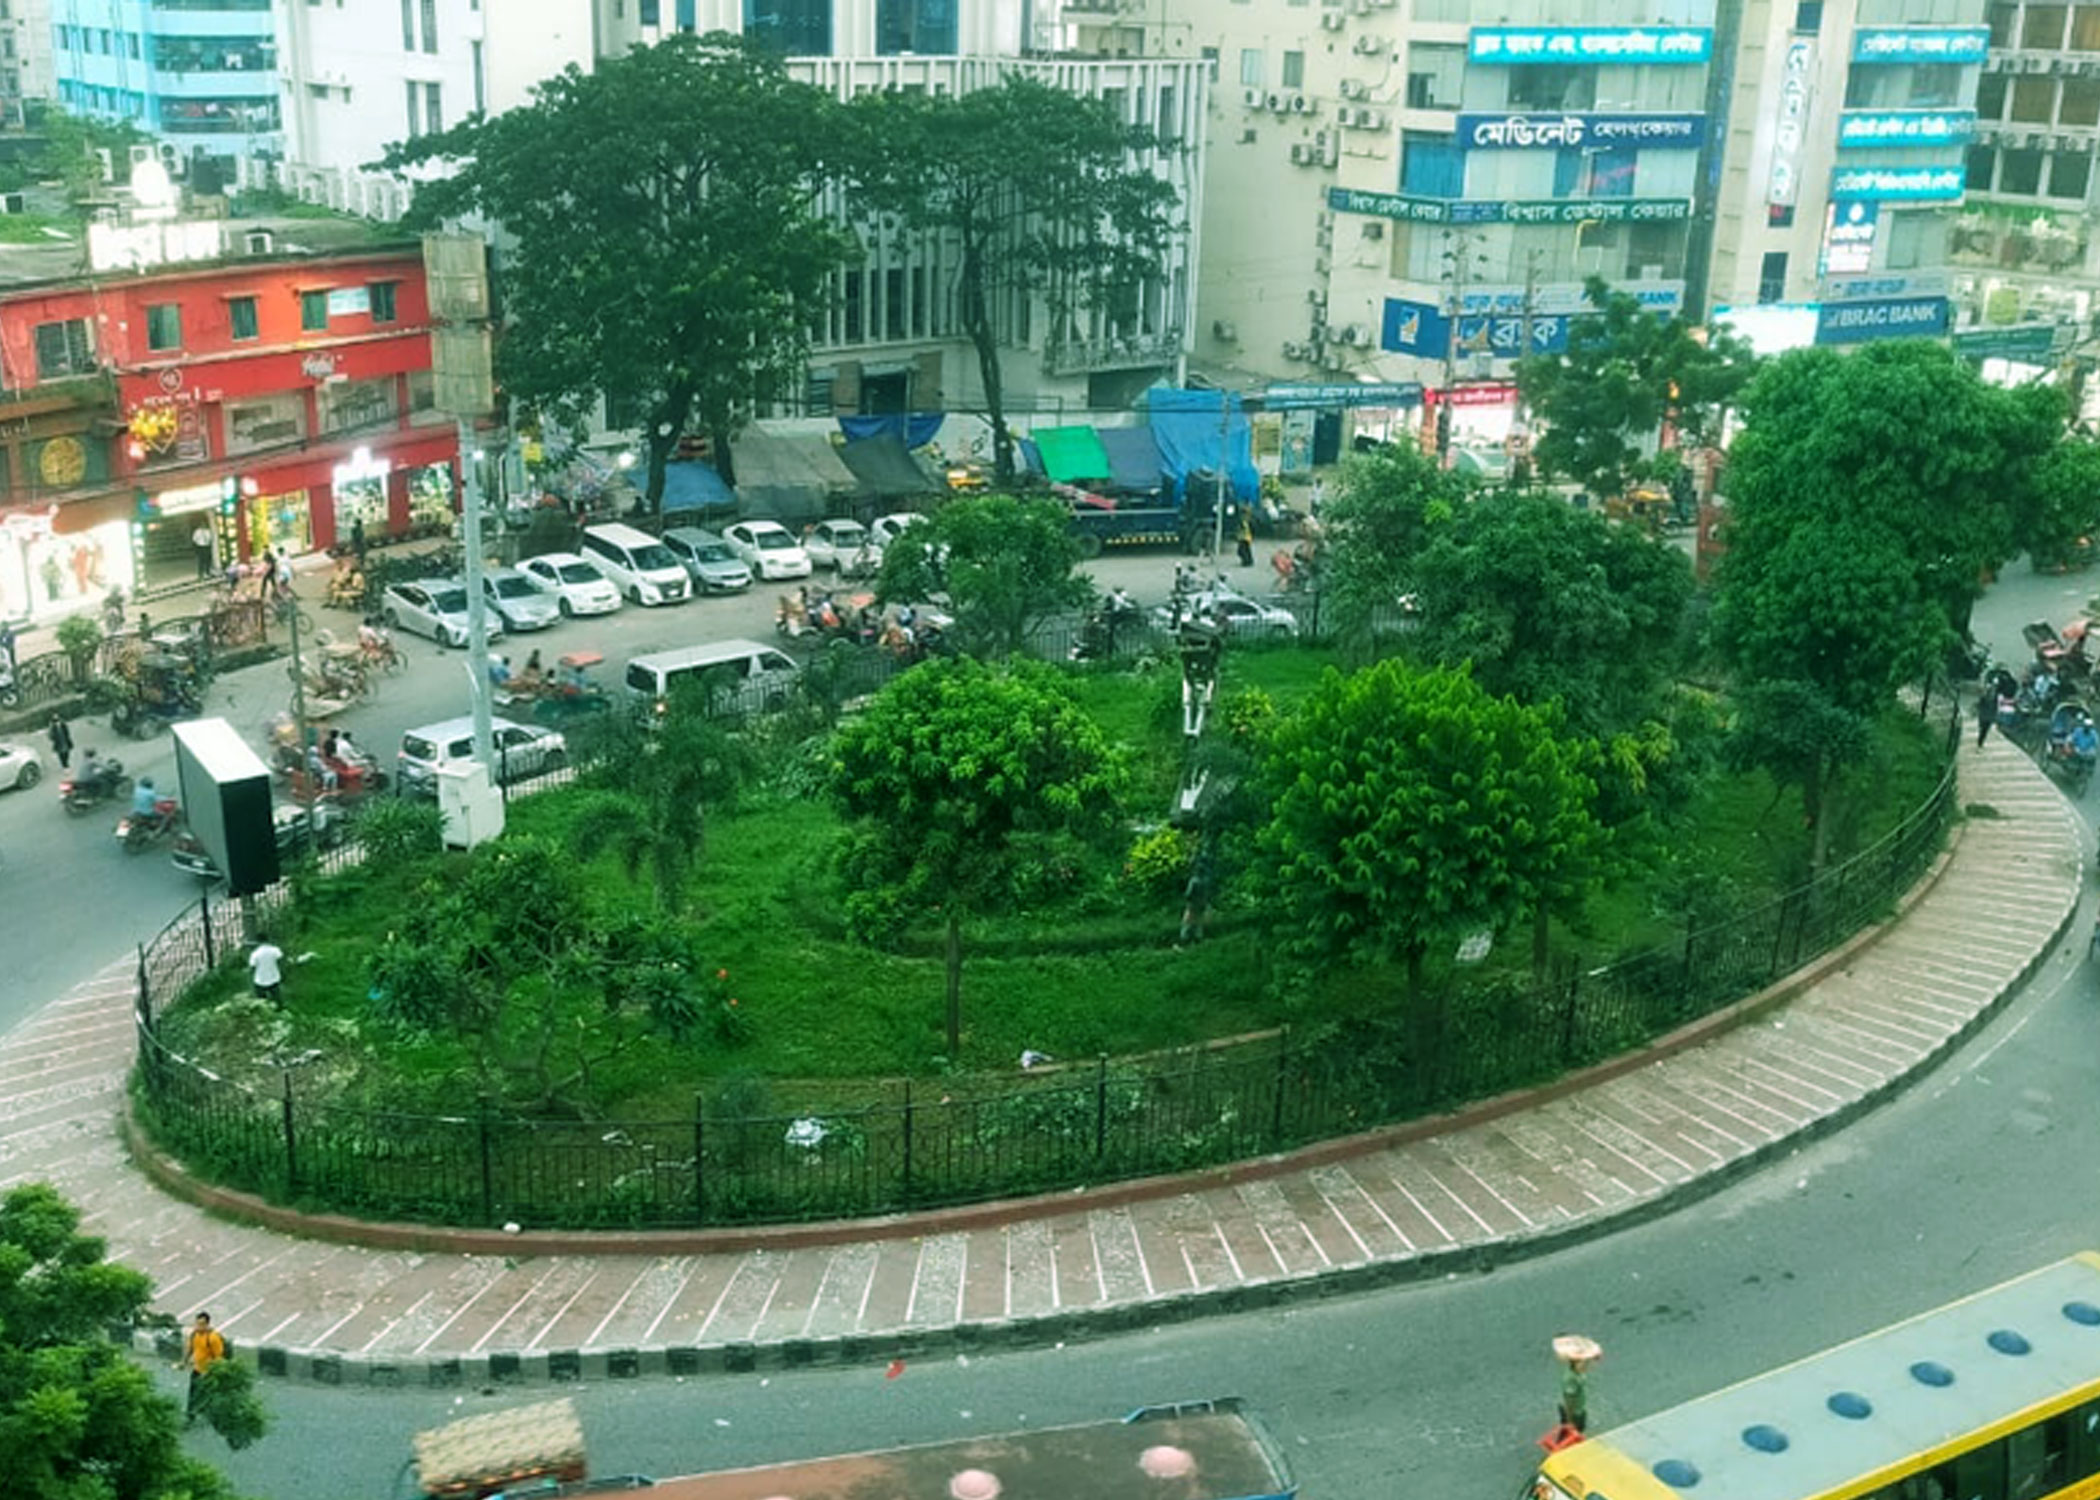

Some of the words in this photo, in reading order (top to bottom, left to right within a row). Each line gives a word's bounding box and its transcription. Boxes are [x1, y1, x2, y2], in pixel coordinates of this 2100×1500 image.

[1474, 116, 1584, 146] মেডিনেট
[1502, 202, 1557, 220] বিশ্বাস
[1840, 307, 1888, 327] BRAC
[1889, 303, 1938, 324] BANK
